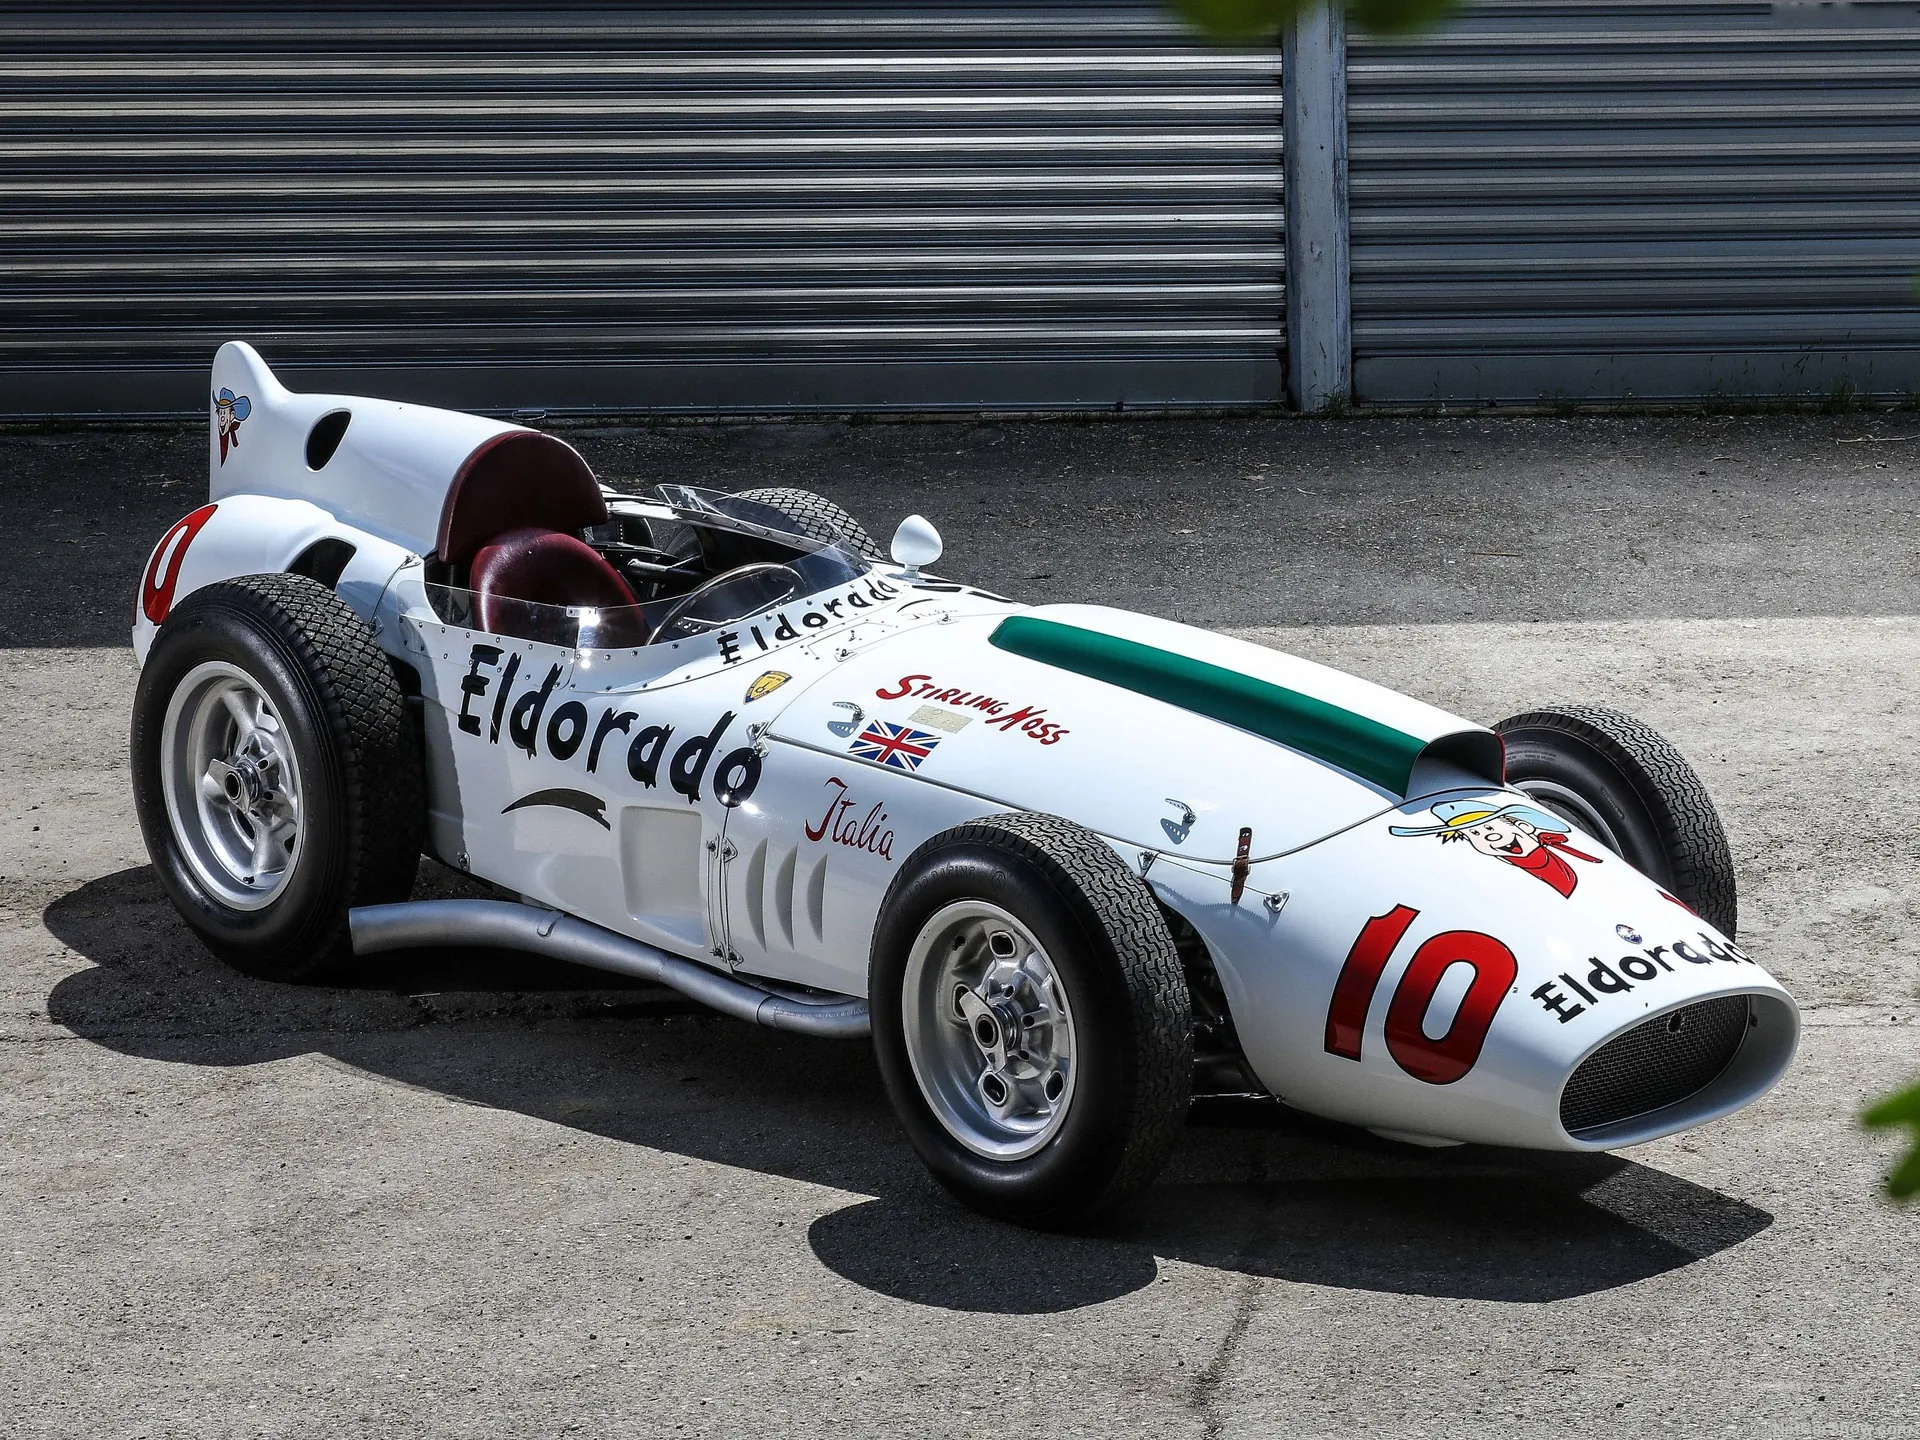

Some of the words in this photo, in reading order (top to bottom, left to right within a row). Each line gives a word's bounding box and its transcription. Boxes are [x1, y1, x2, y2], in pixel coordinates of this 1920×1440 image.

[716, 578, 900, 665] Eldorado
[457, 643, 762, 808] Eldorado
[875, 674, 1009, 716] STIRLING
[984, 705, 1070, 745] MOSS
[804, 776, 894, 862] Italia
[930, 862, 976, 883] RACING
[1323, 903, 1519, 1085] 10
[1529, 931, 1756, 1025] Eldorado
